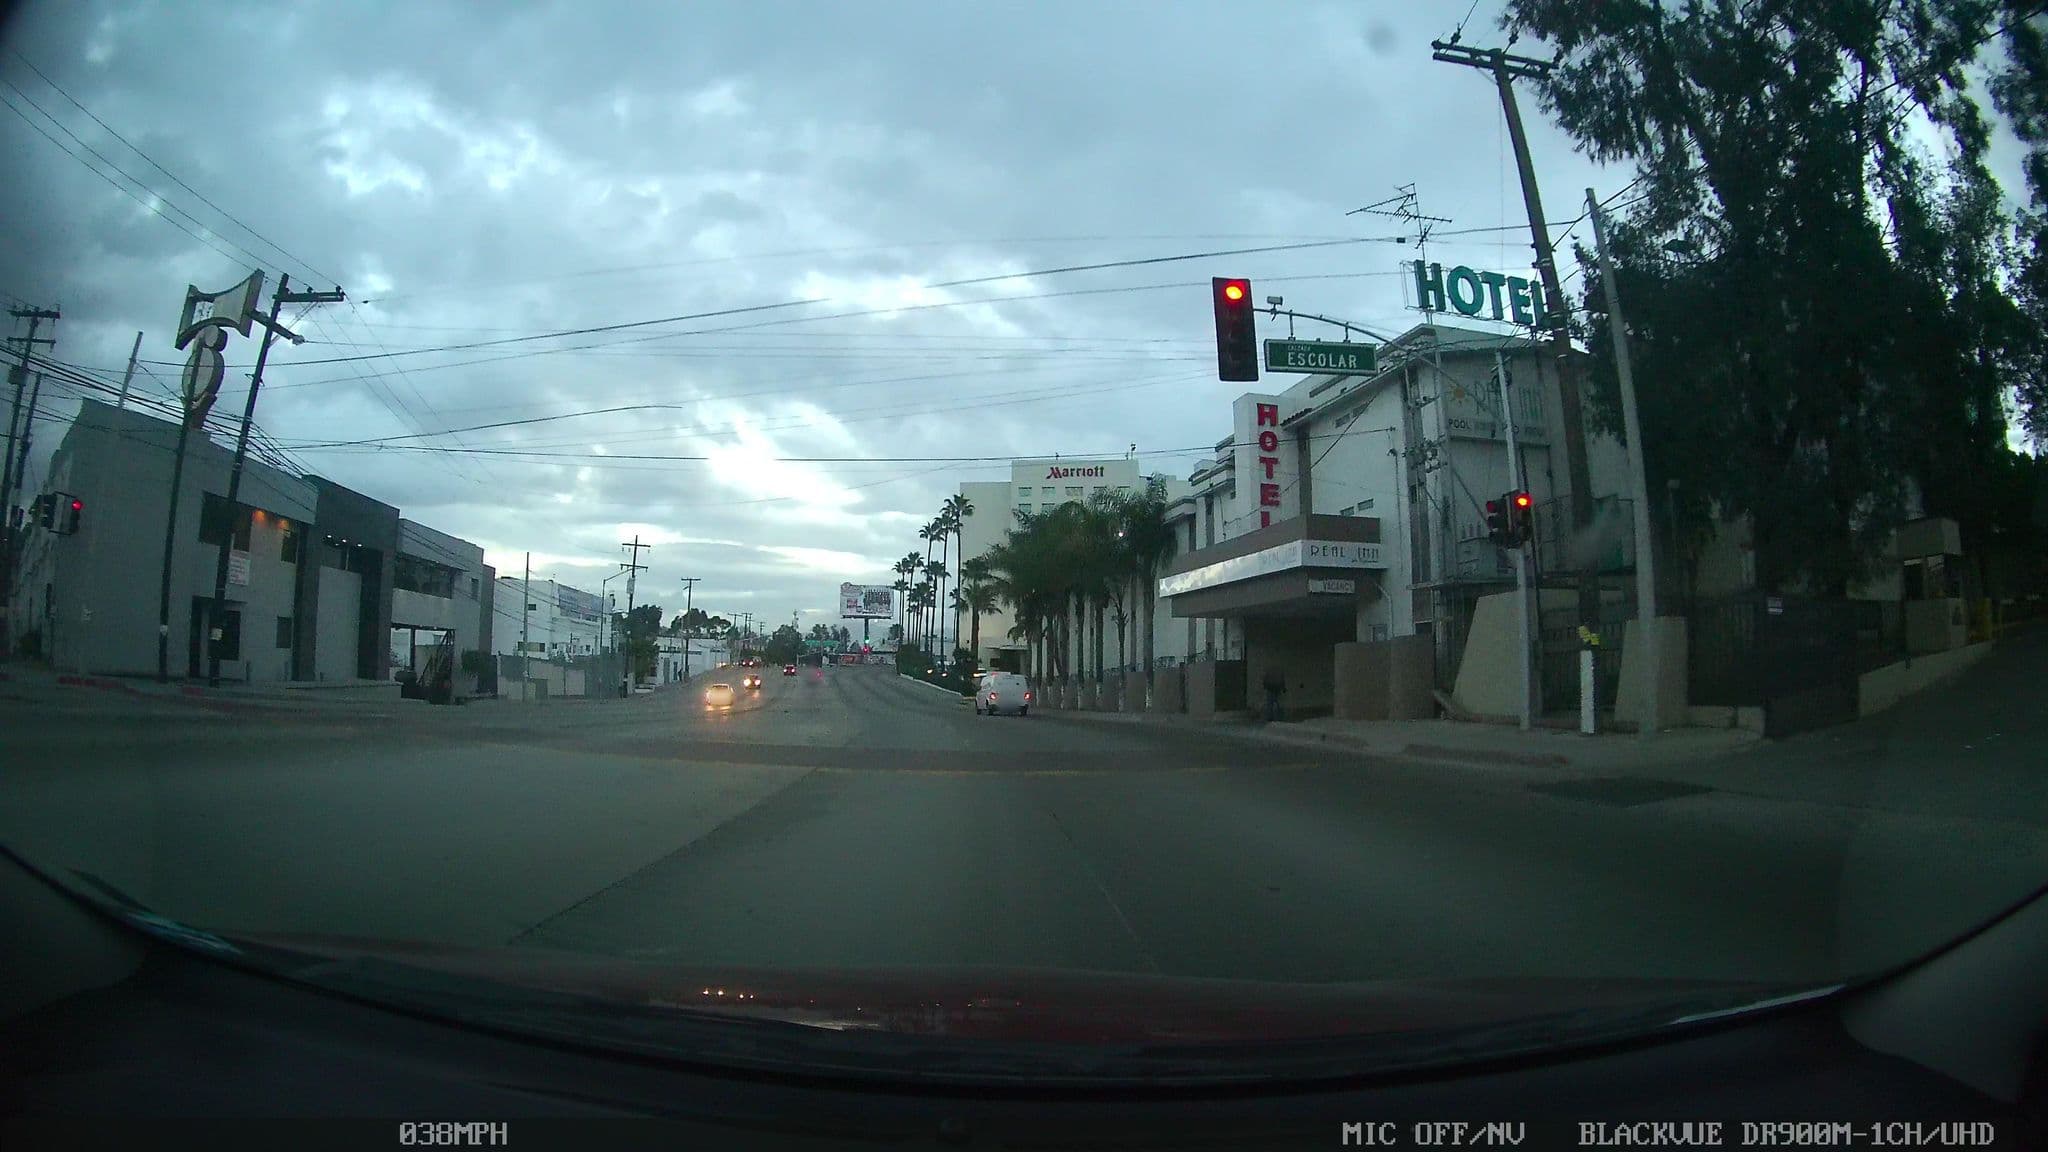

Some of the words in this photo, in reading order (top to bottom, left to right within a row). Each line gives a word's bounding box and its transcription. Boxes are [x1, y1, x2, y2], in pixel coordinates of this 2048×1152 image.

[1287, 352, 1357, 369] ESCOLAR
[1046, 466, 1104, 480] Marriott
[1310, 544, 1346, 558] REAL
